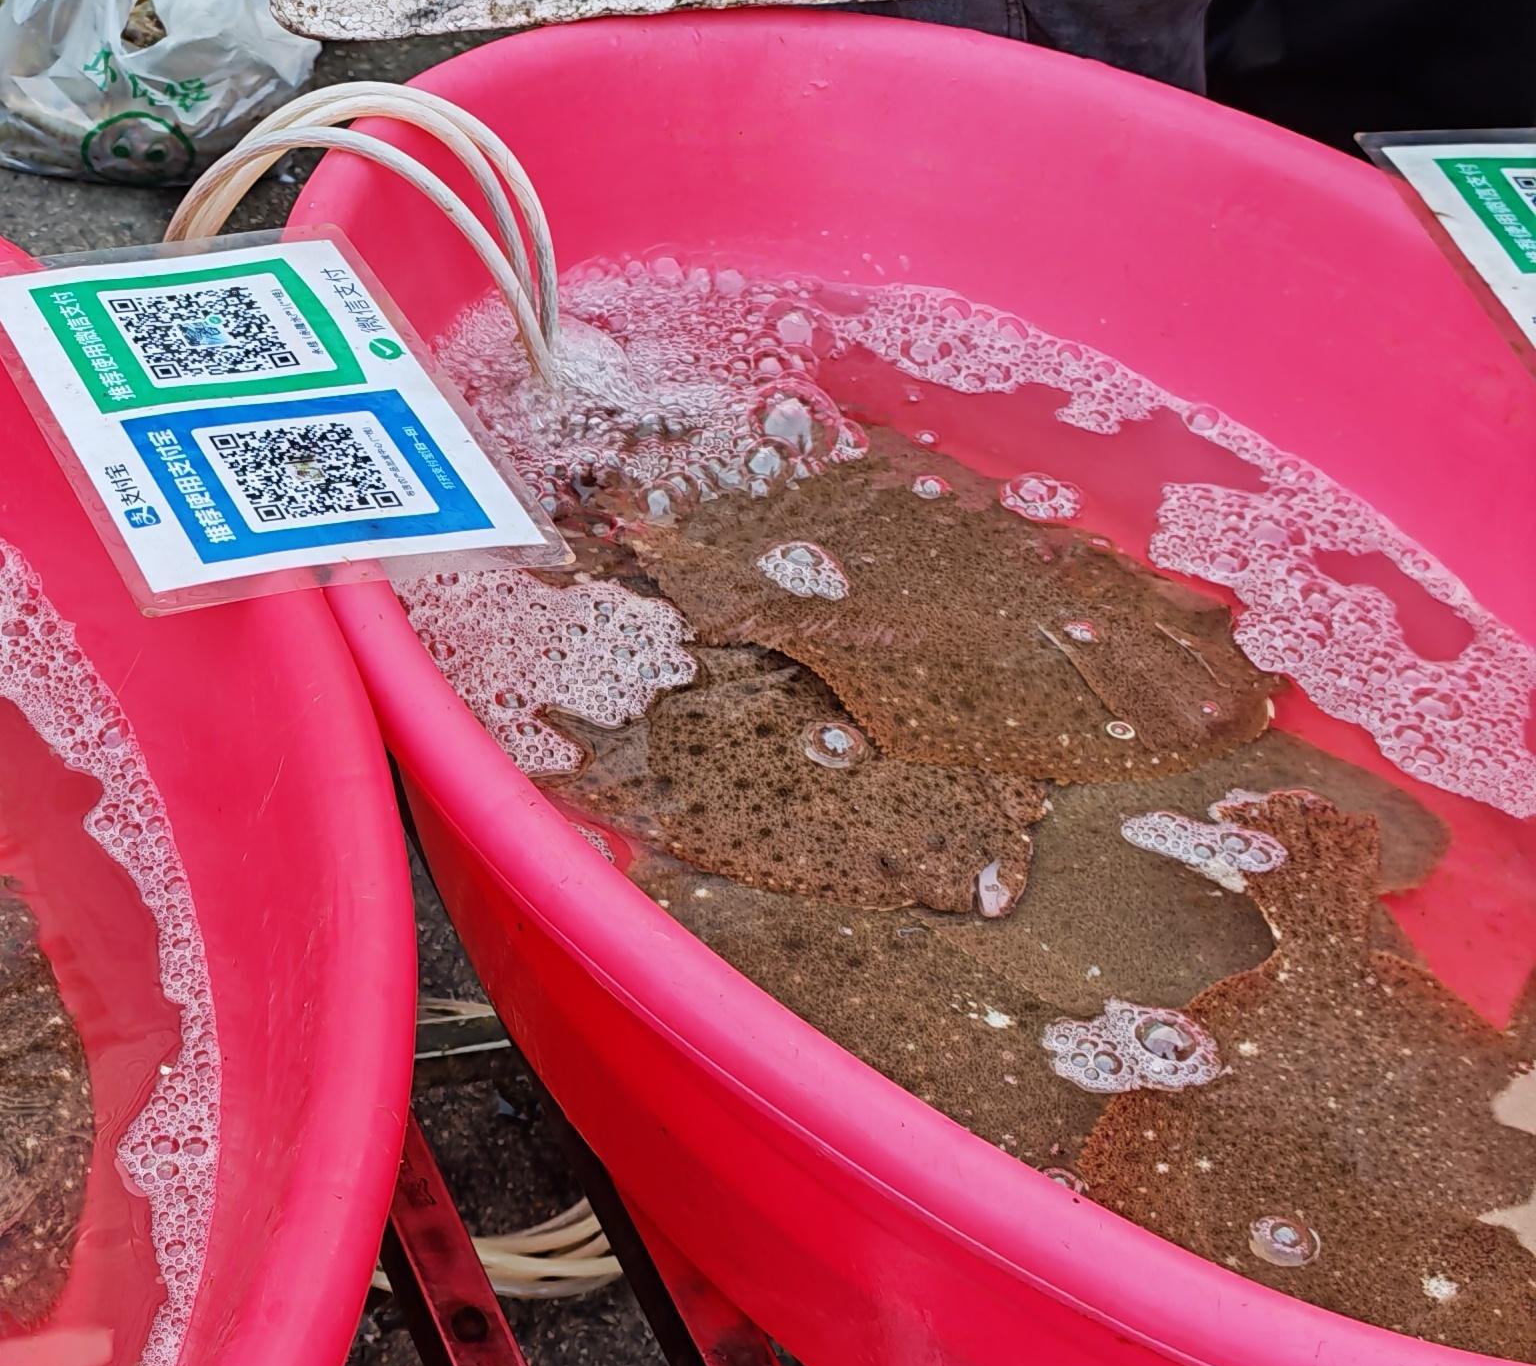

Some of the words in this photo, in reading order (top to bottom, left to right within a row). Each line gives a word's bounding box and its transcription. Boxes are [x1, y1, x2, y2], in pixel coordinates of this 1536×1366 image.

[319, 266, 388, 333] 微信支付
[50, 290, 137, 401] 推荐使用微信支付
[103, 463, 146, 506] 支付宝
[146, 429, 237, 543] 推荐使用支付宝
